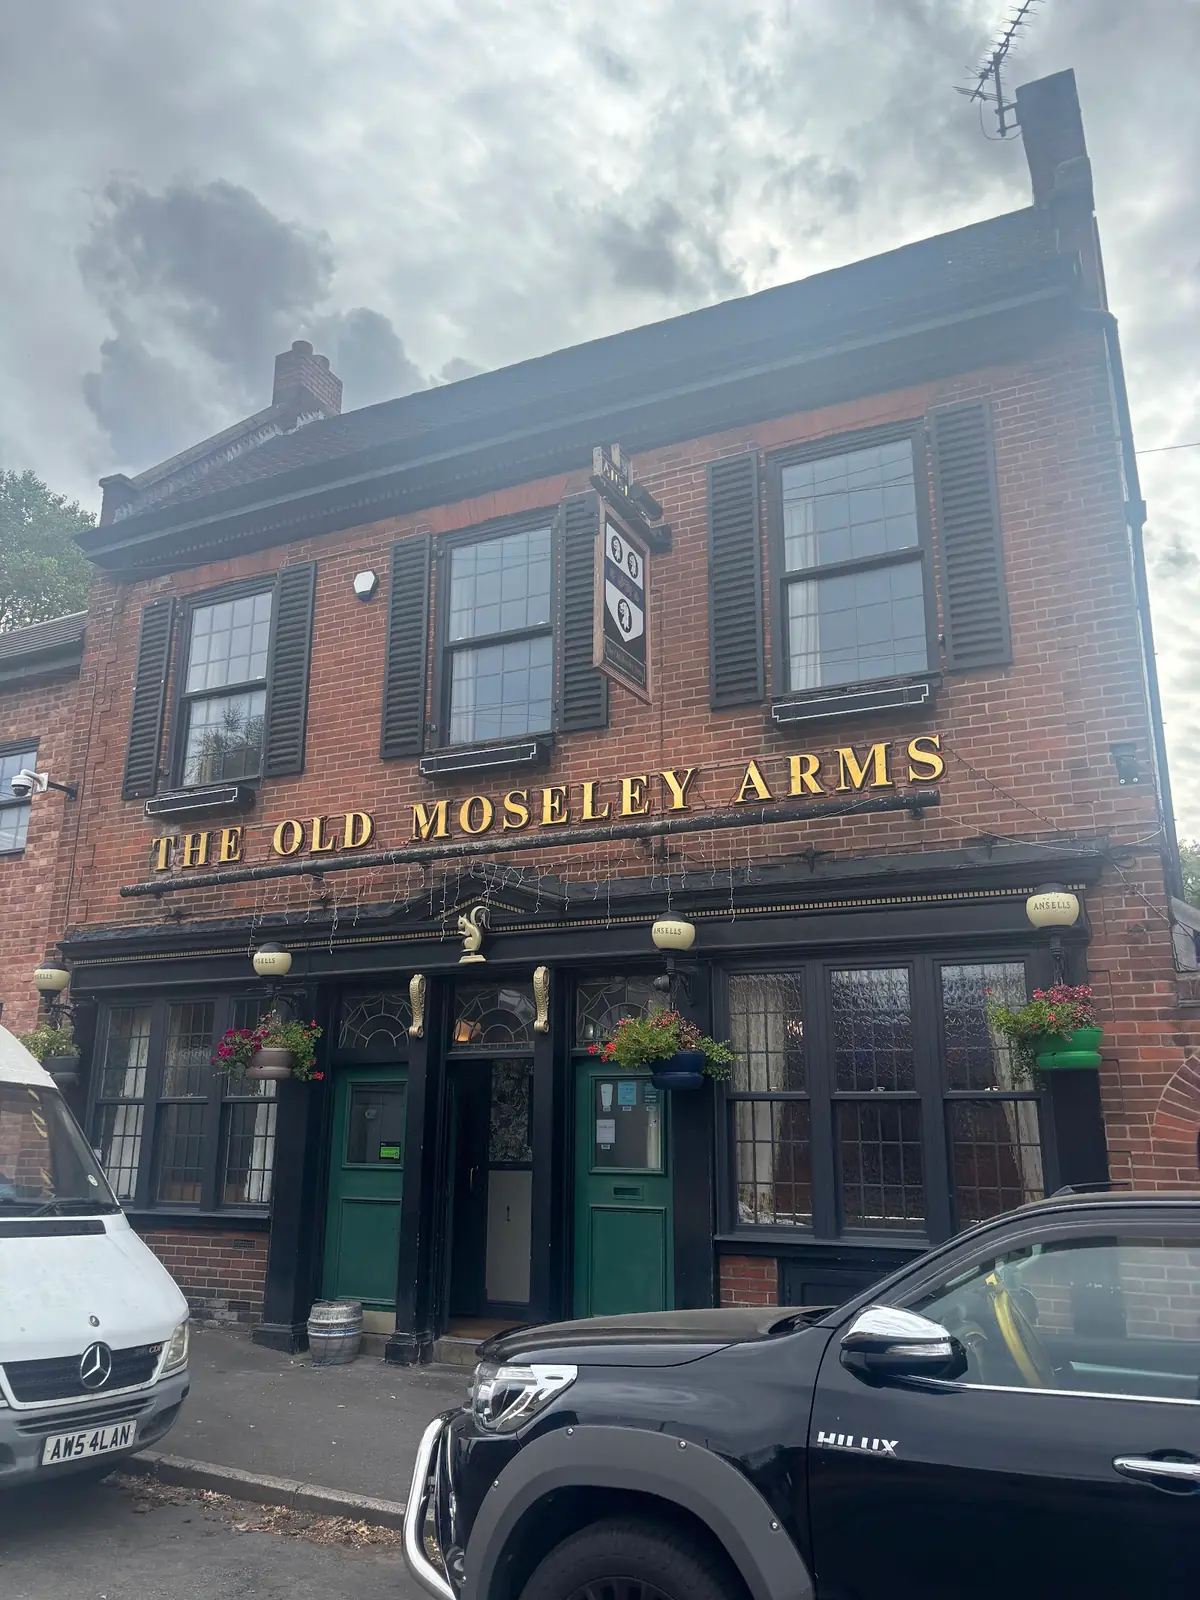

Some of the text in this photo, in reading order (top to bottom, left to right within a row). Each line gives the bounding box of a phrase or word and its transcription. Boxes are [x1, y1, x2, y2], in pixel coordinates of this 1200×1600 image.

[152, 734, 945, 872] THE OLD MOSELEY ARMS
[1033, 901, 1071, 911] ANSELLS
[50, 1424, 131, 1461] AW54LAN
[817, 1431, 899, 1457] HILUX
